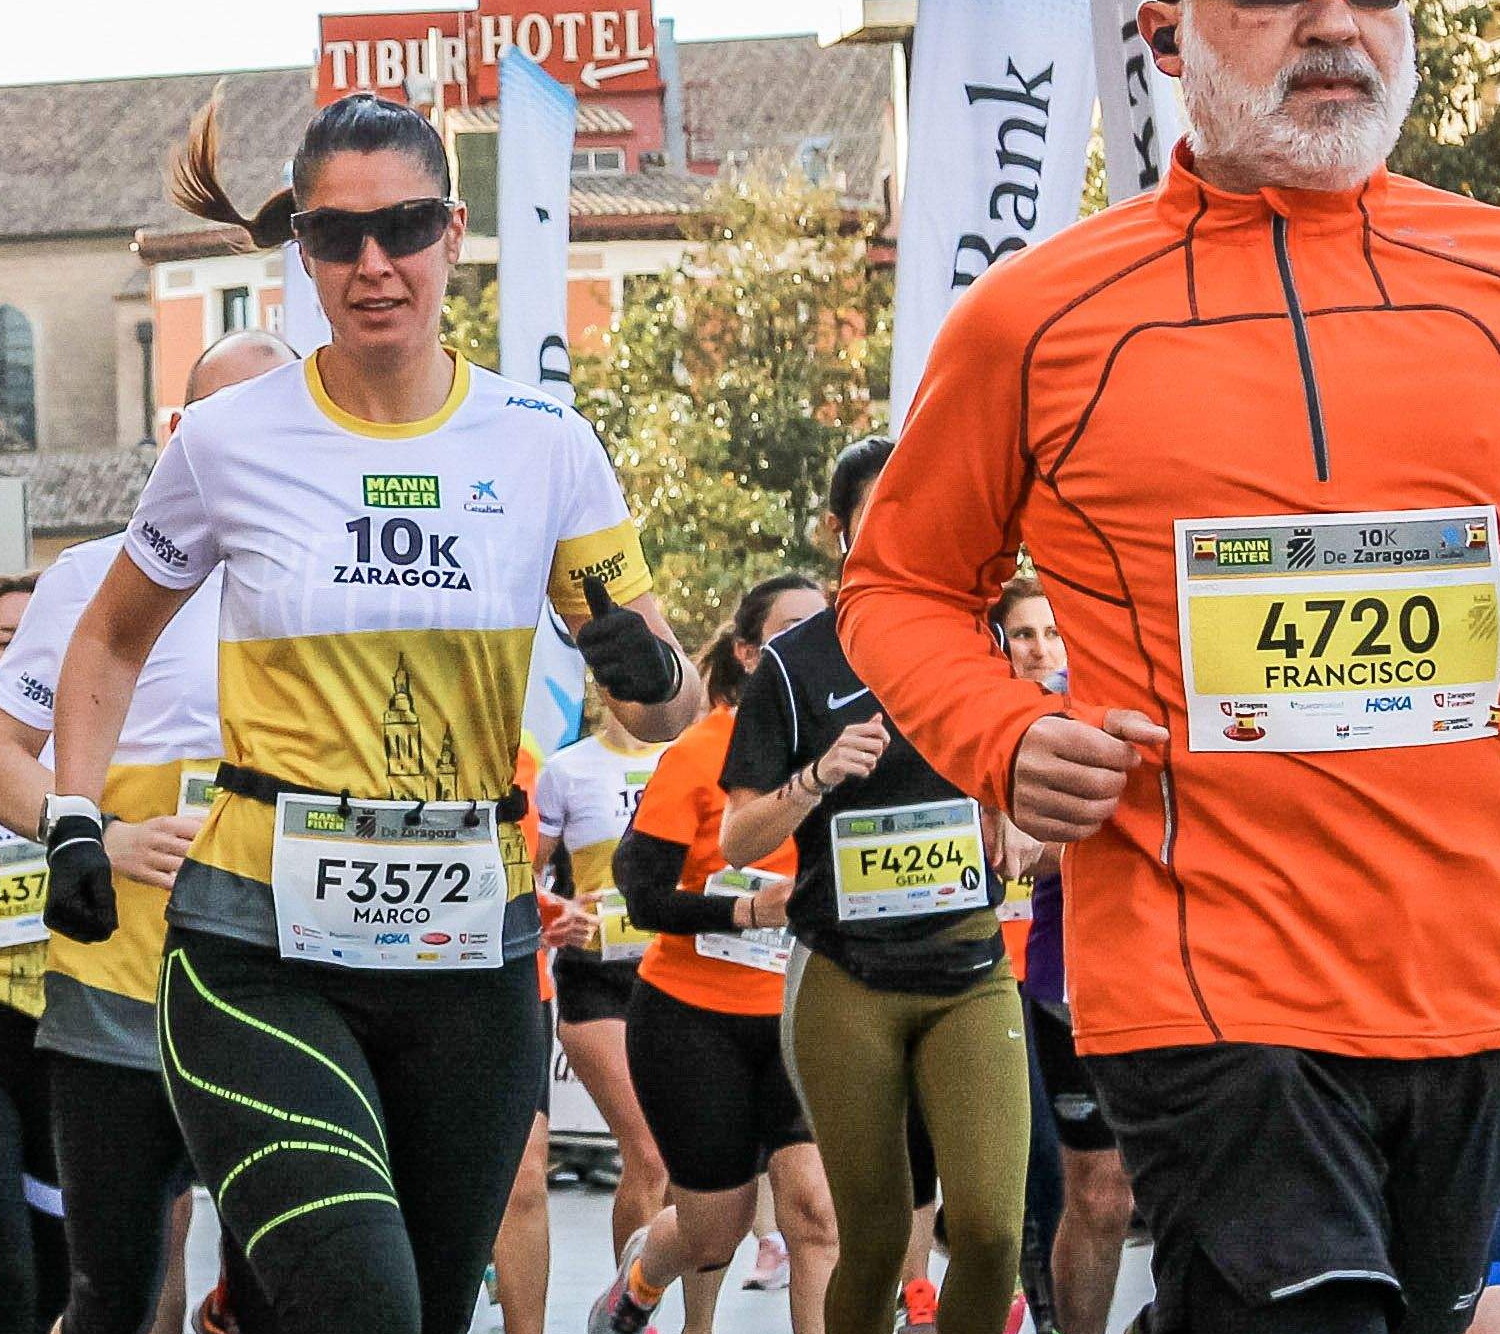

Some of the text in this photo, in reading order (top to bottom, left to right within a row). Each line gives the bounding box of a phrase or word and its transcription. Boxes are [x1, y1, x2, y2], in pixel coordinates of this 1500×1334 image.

[479, 8, 654, 64] HOTEL
[323, 35, 466, 89] TIBUR
[951, 56, 1056, 293] Bank
[506, 395, 564, 419] HOKA
[367, 477, 436, 492] MANN
[367, 491, 439, 507] FILTER
[345, 516, 462, 569] 10K
[1219, 539, 1270, 553] MANN
[1219, 551, 1271, 565] FILTER
[1323, 549, 1347, 565] De
[1352, 548, 1431, 565] Zaragoza
[332, 565, 473, 591] ZARAGOZA
[1255, 594, 1442, 660] 4720
[1264, 658, 1437, 689] FRANCISCO
[1365, 696, 1413, 713] HOKA
[306, 819, 345, 832] FILTER
[400, 828, 458, 840] Zaragoza
[859, 840, 965, 876] F4264
[314, 857, 472, 906] F3572
[895, 873, 936, 886] GEMA
[353, 907, 431, 925] MARCO
[374, 932, 412, 946] HOKA
